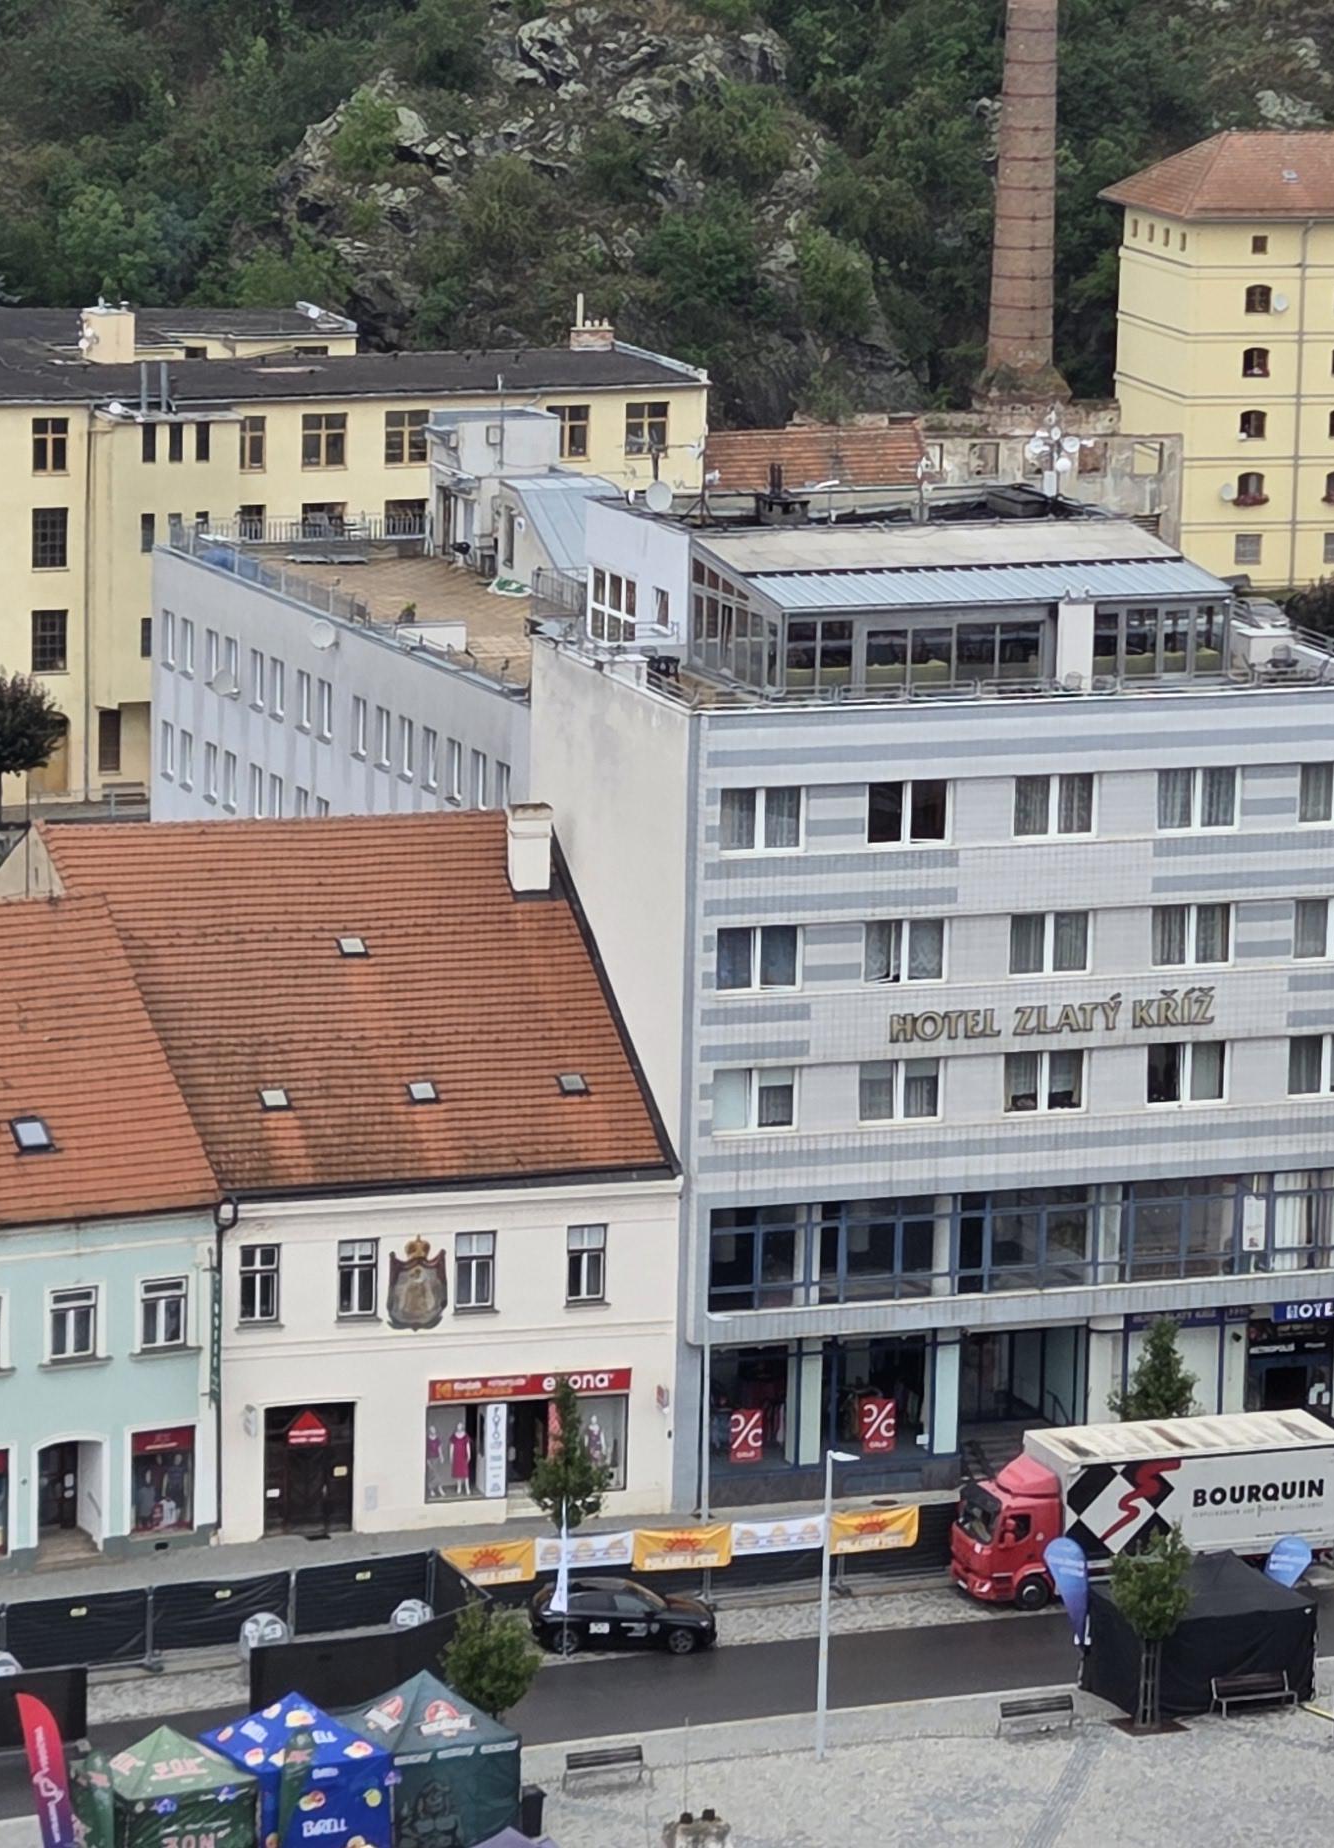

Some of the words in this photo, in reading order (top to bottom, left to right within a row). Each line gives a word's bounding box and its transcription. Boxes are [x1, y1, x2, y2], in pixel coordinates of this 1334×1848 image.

[889, 1008, 1001, 1044] HOTEL
[1013, 993, 1122, 1036] ZLATÝ
[1132, 987, 1216, 1027] KŘÍŽ
[542, 1371, 612, 1392] eona
[1192, 1478, 1324, 1508] BOURQUIN
